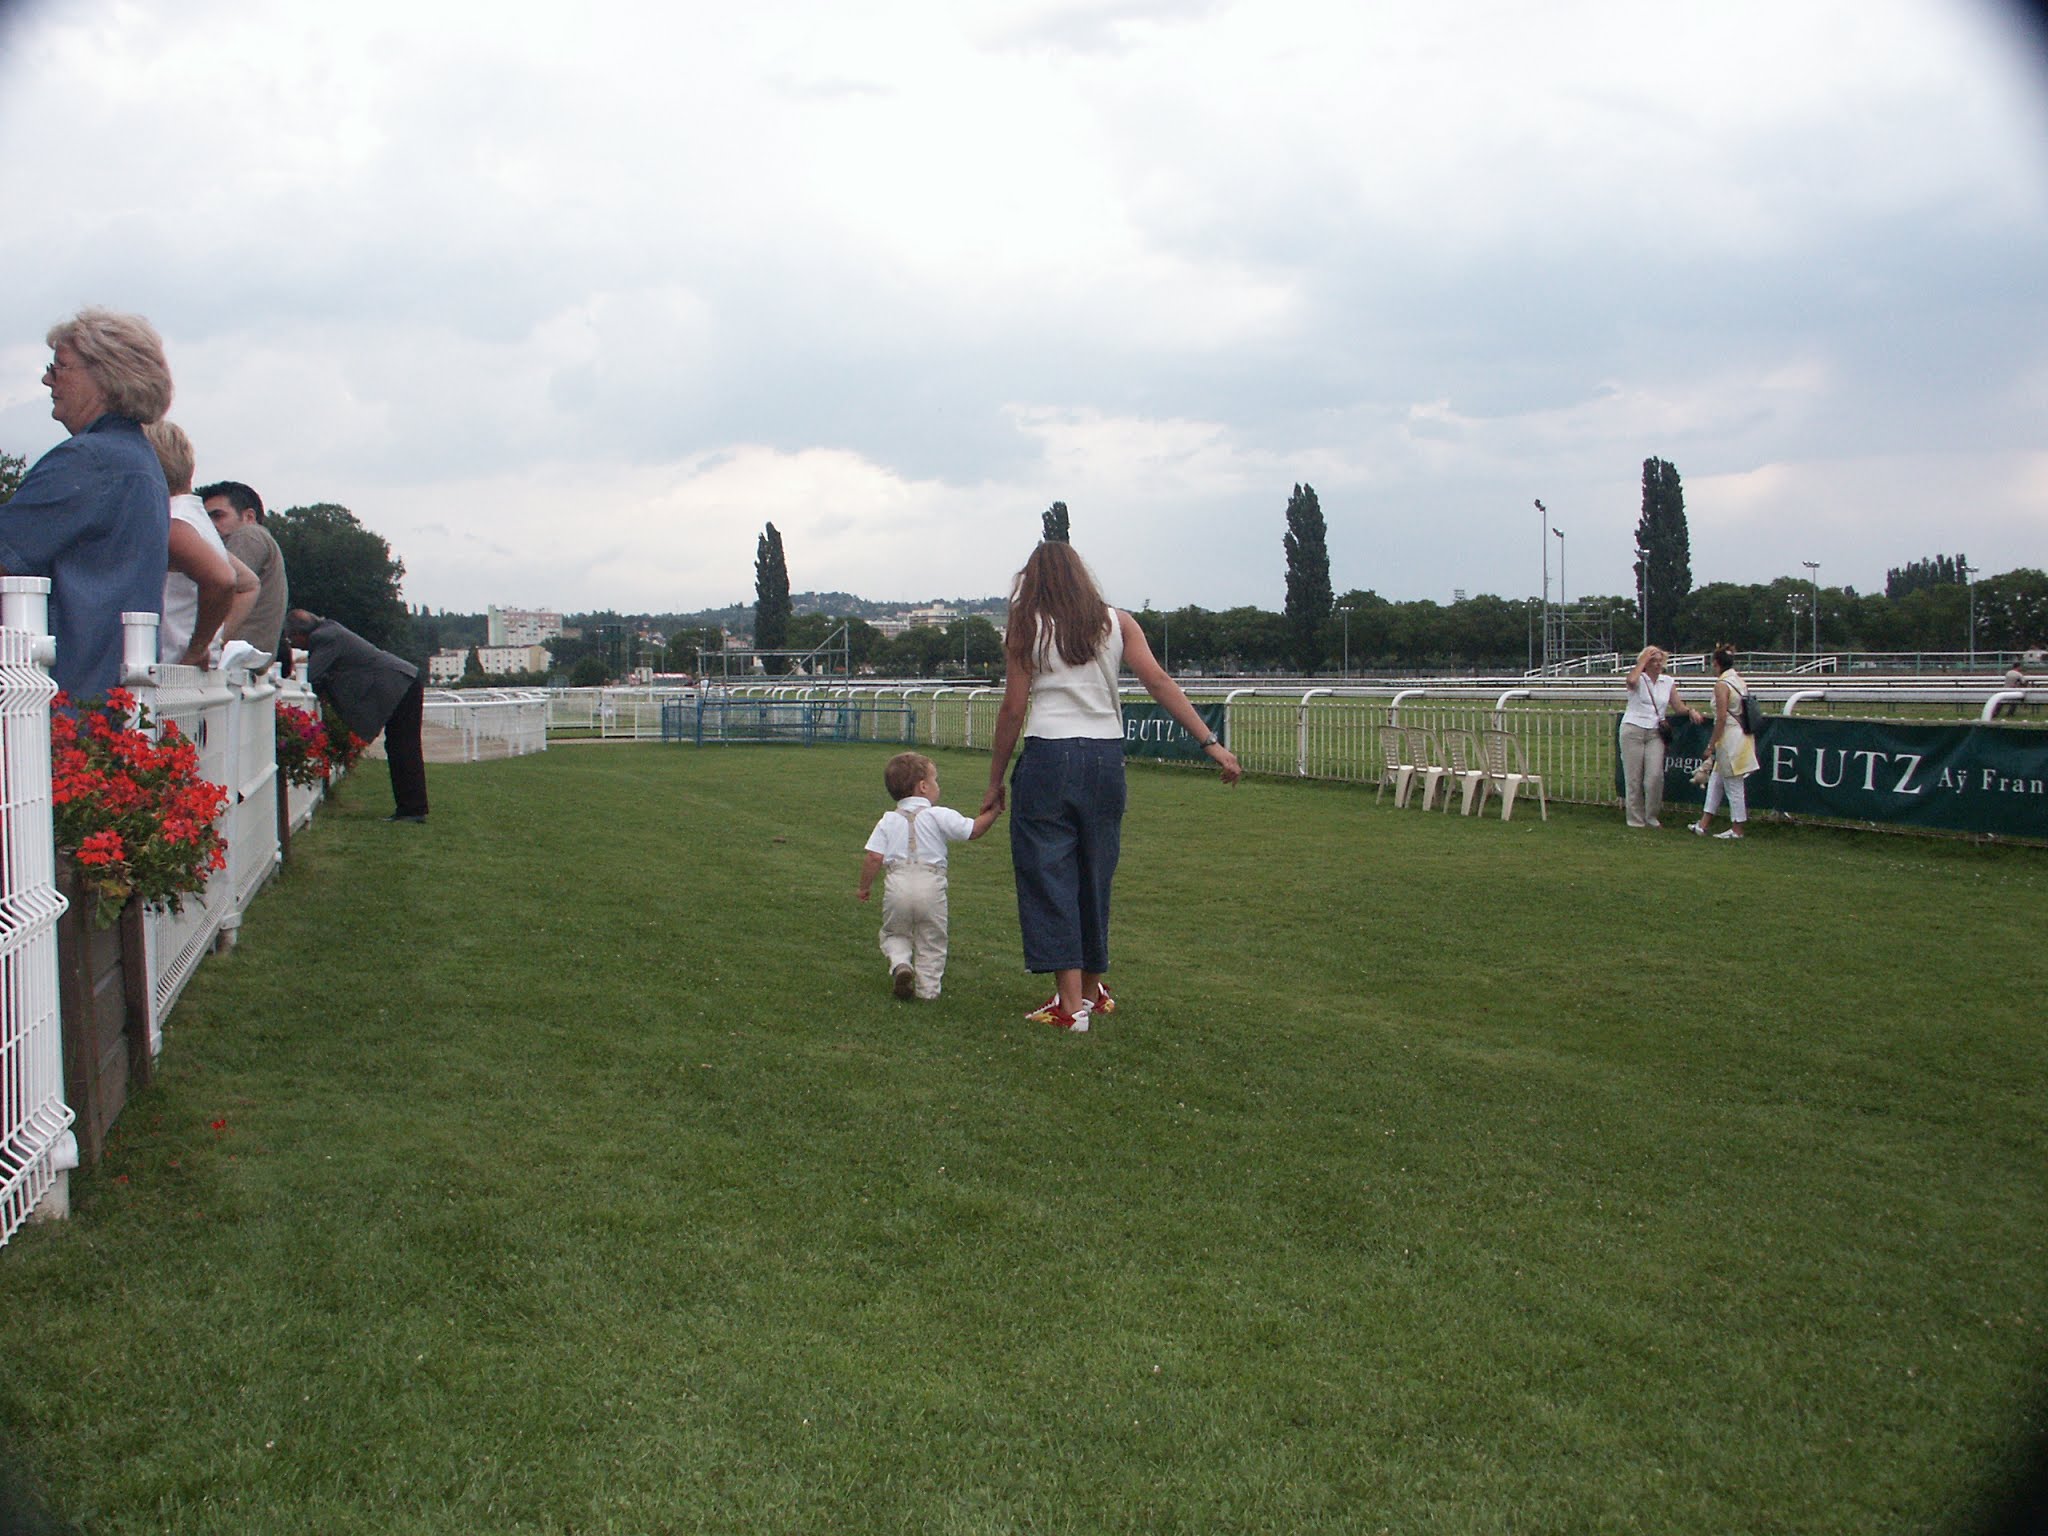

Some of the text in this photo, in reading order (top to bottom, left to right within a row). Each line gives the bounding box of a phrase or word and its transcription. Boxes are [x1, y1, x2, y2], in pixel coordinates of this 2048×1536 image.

[1127, 719, 1174, 742] EUTZ
[1772, 745, 1922, 794] EUTZ
[1981, 768, 2044, 794] Fran
